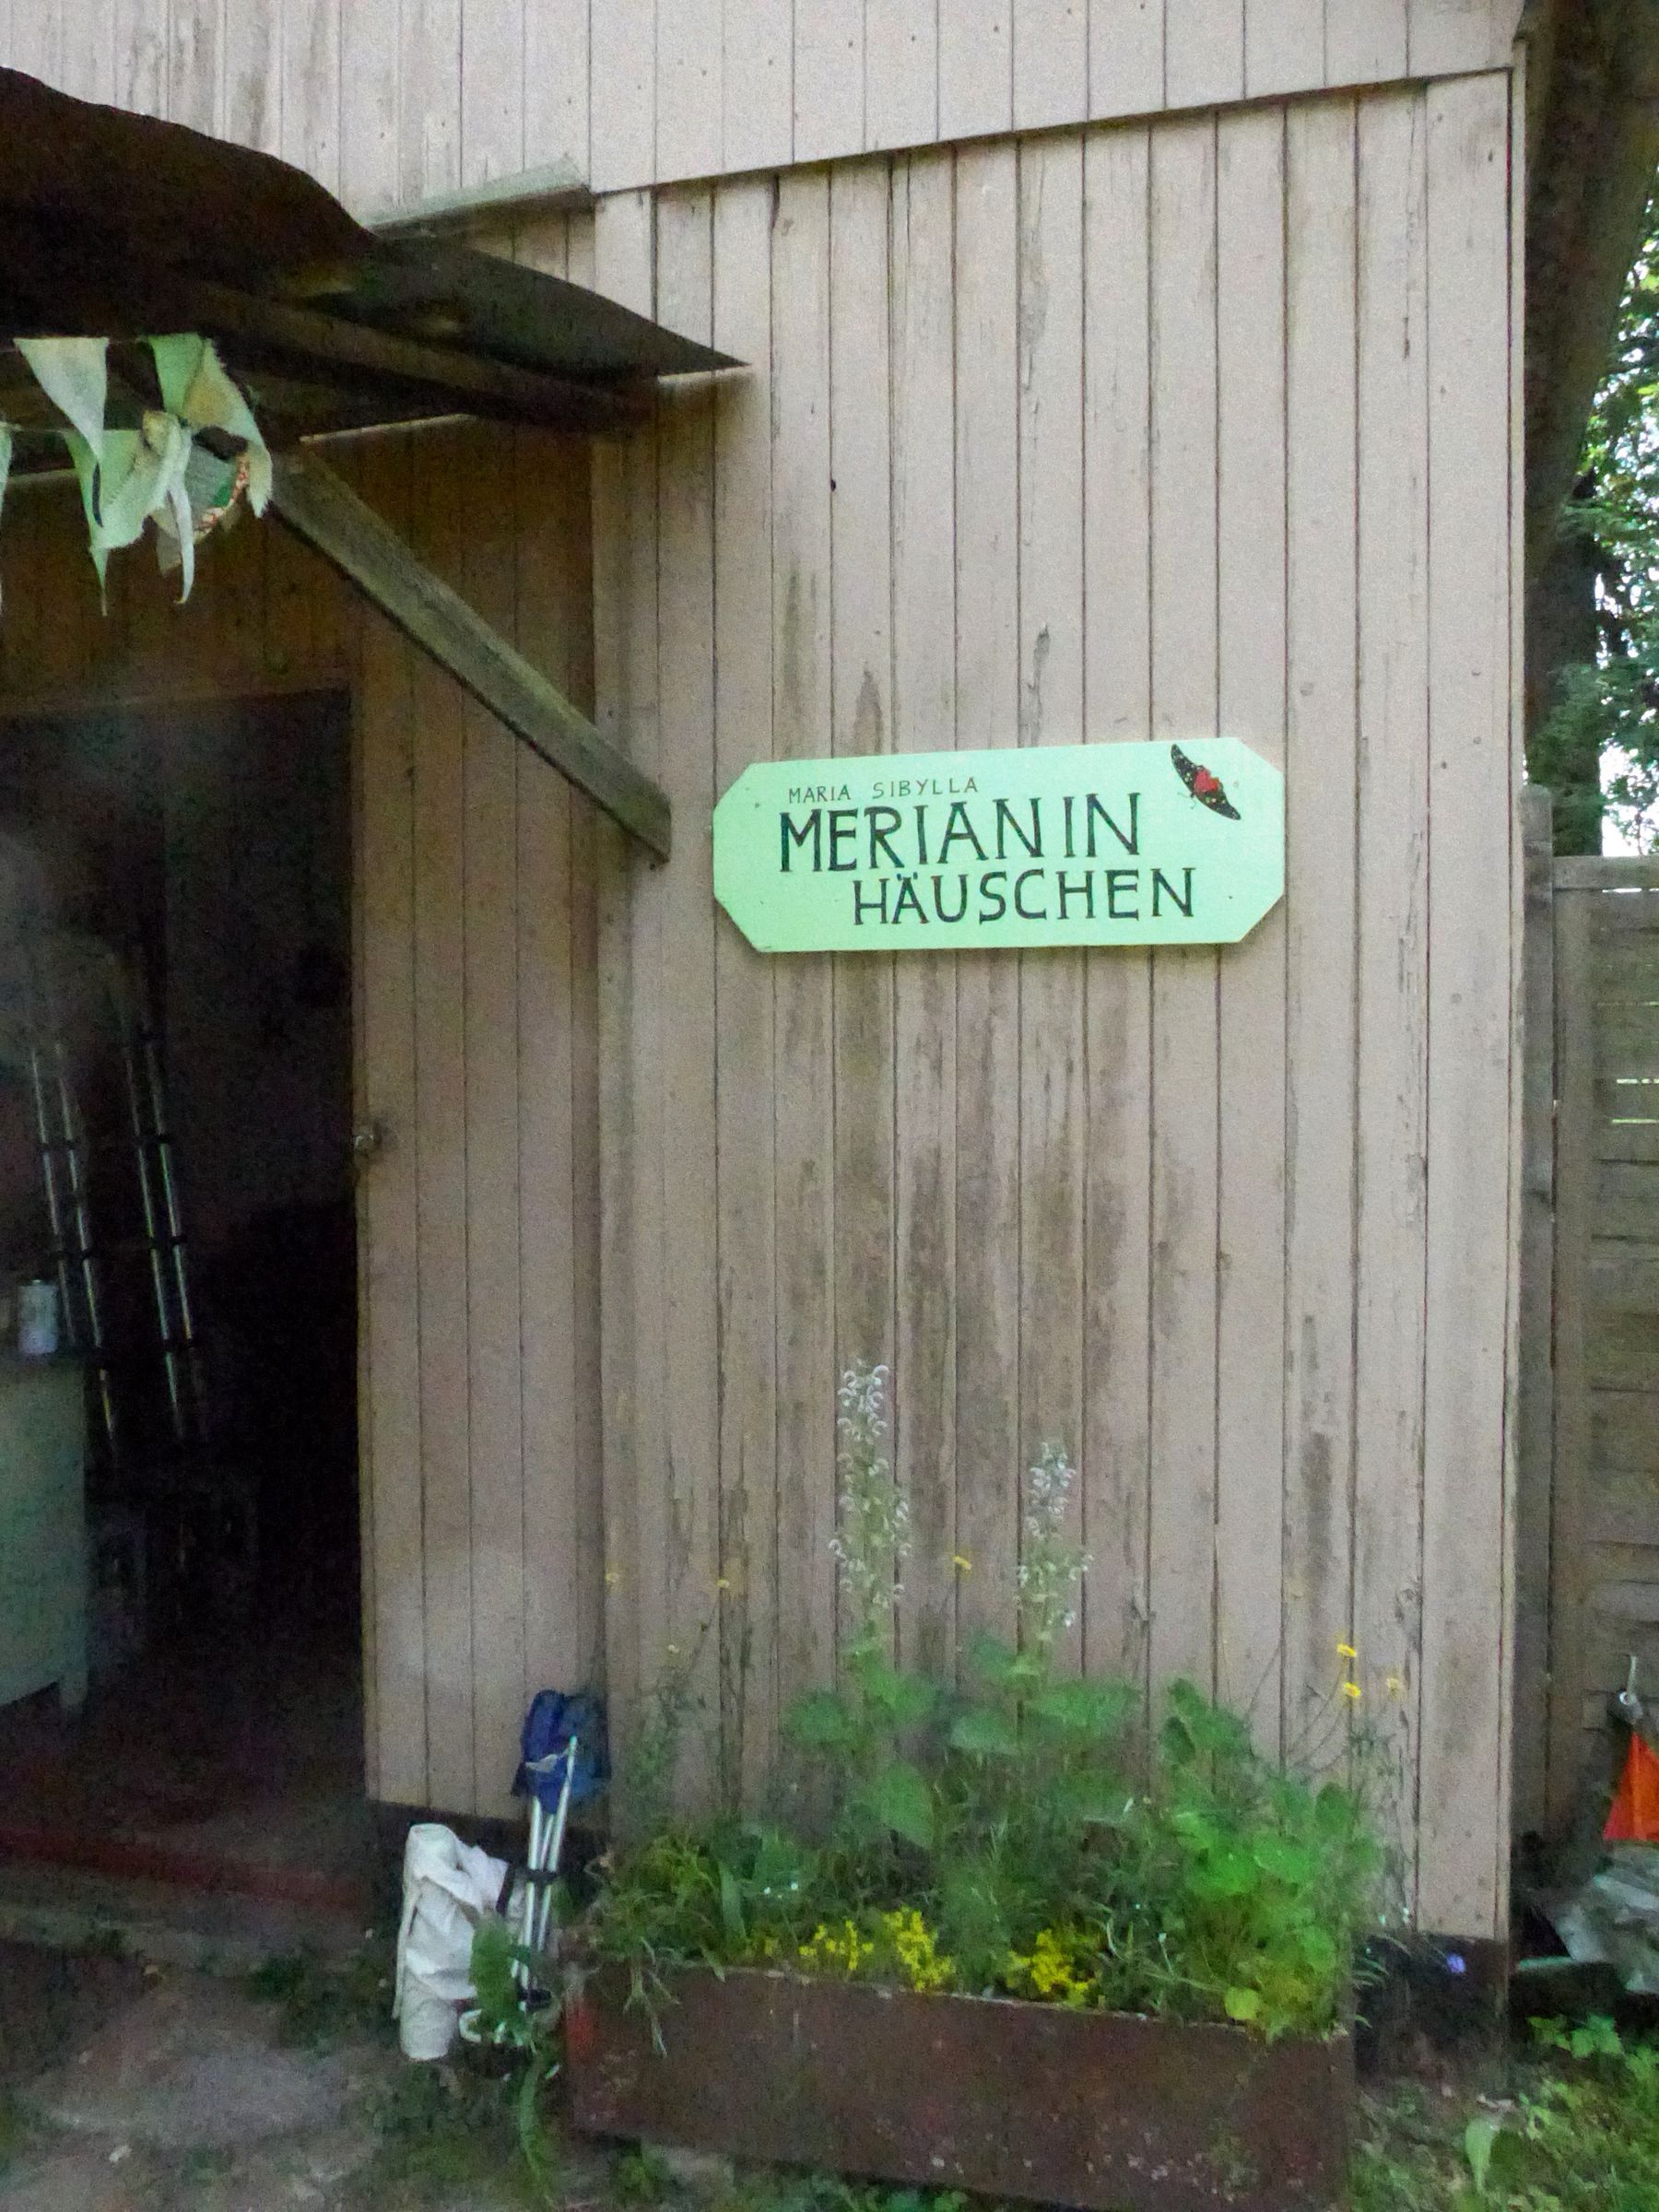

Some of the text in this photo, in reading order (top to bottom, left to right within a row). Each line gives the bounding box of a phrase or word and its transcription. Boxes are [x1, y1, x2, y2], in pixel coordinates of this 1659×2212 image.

[789, 777, 979, 805] MARIA SIBYLLA
[853, 867, 1196, 925] HÄUSCHEN
